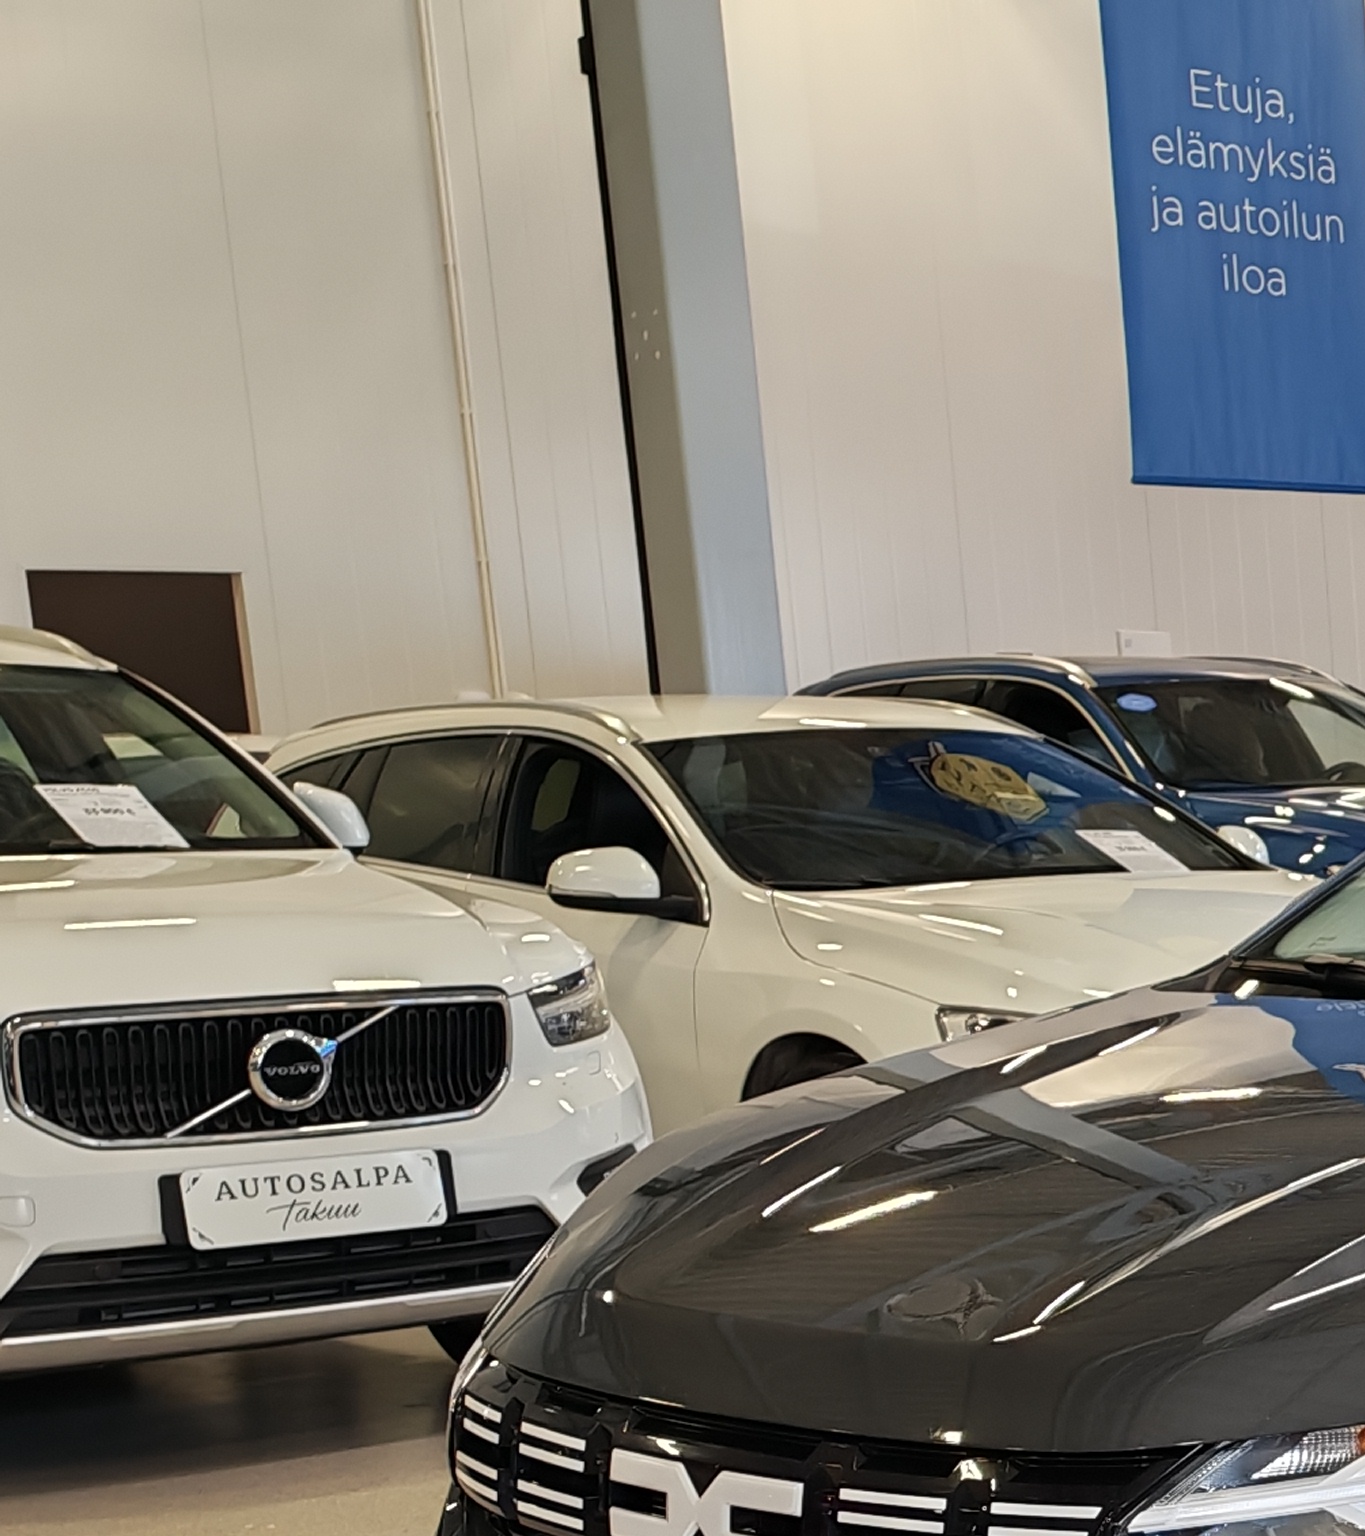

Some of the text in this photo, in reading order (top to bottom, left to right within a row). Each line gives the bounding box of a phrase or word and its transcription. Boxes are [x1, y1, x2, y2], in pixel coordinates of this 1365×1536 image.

[1189, 68, 1294, 124] Etuja,
[1151, 125, 1336, 184] elämyksiä
[1151, 185, 1345, 243] ja autoilun
[1222, 253, 1287, 296] iloa
[264, 1062, 321, 1077] VOLVO
[215, 1164, 413, 1202] AUTOSALPA
[266, 1198, 361, 1232] Takuu
